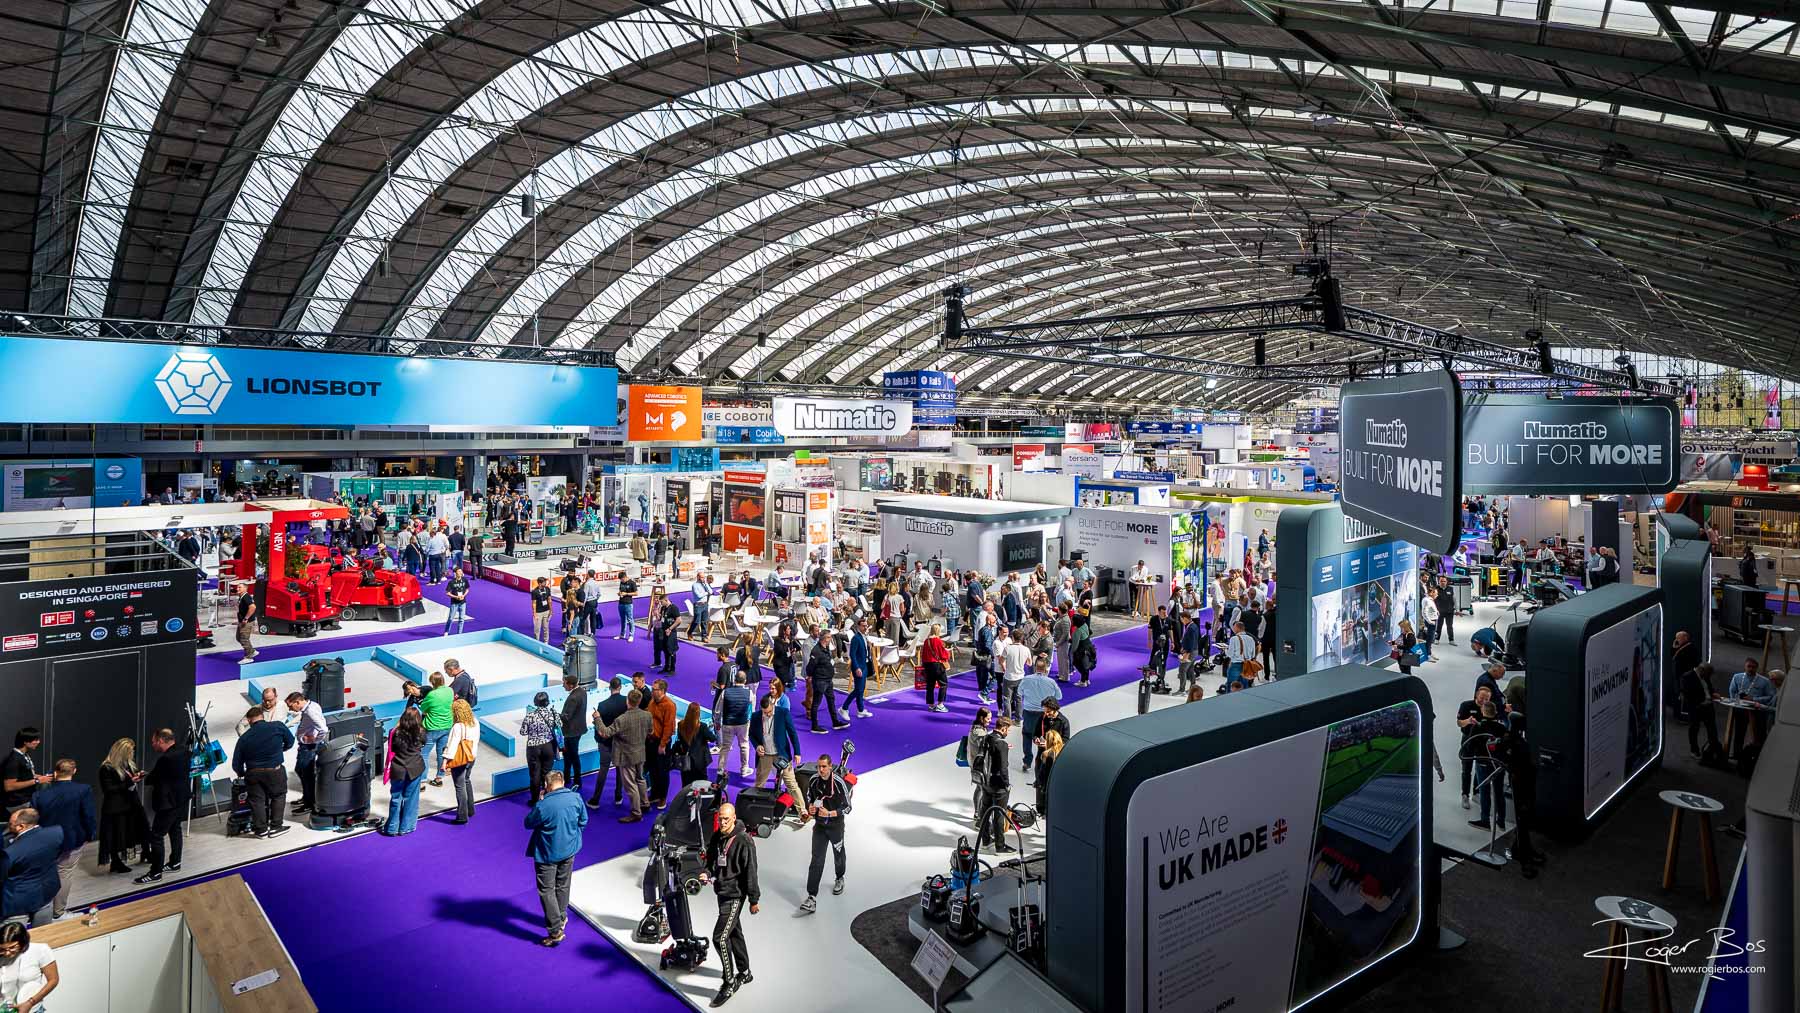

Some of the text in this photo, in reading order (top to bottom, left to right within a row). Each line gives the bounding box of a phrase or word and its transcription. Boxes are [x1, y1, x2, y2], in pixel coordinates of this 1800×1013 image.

[247, 378, 382, 397] LIONSBOT
[703, 412, 721, 421] ICE
[795, 403, 896, 431] Numatic
[1366, 418, 1408, 449] Numatic
[1524, 421, 1607, 440] Numatic
[1468, 444, 1662, 465] BUILT FOR MORE
[1345, 449, 1443, 498] BUILT FOR MORE
[905, 518, 954, 536] Numatic
[1079, 518, 1102, 529] BUILT
[1105, 520, 1124, 531] FOR
[1127, 522, 1158, 535] MORE
[274, 532, 283, 553] NEW
[597, 542, 619, 552] CLEAN!
[1010, 547, 1037, 561] MORE
[20, 580, 172, 600] DESIGNED AND ENGINEERED
[52, 592, 128, 606] IN SINGAPORE
[1592, 667, 1629, 703] INNOVATING
[1159, 815, 1229, 855] We Are
[1159, 824, 1268, 891] UK MADE
[1216, 997, 1235, 1013] MORE
